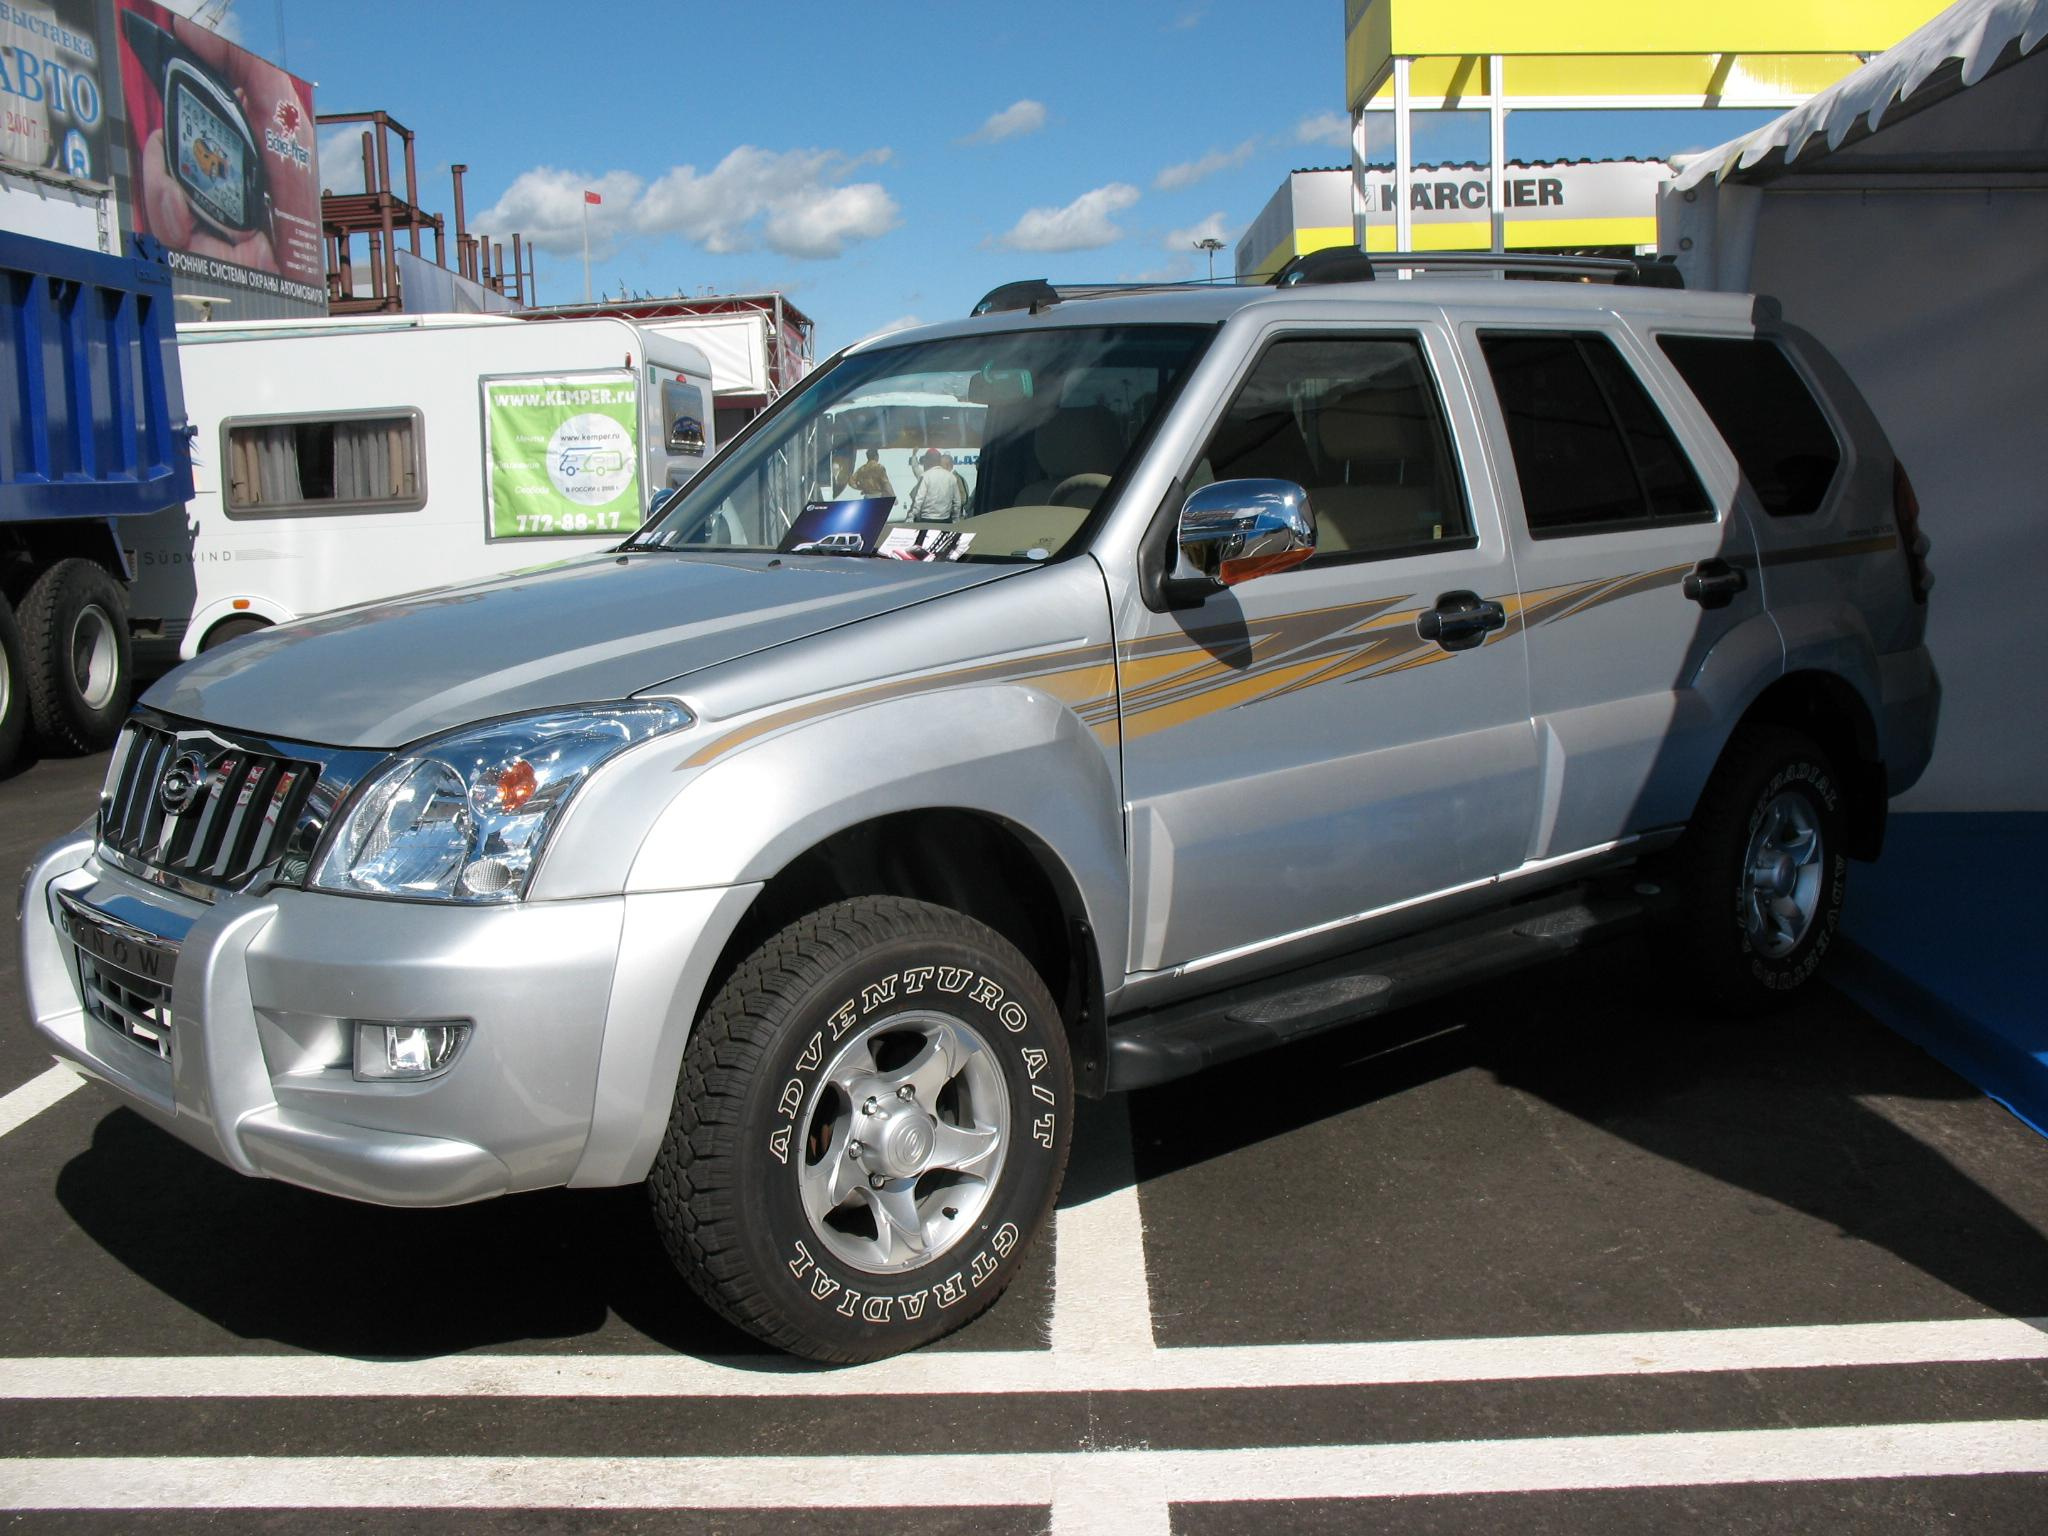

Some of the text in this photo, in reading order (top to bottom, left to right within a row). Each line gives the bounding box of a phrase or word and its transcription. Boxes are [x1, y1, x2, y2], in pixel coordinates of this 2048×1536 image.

[1381, 178, 1563, 211] KÄRCHER
[167, 252, 323, 303] ОРОННИЕ СИСТЕМЫ ОХРАНЫ АВТОМОБИЛЯ
[494, 388, 635, 407] www.KEMPER.ru
[516, 511, 620, 533] 772-88-17
[769, 966, 1055, 1164] ADVENTURO A/T
